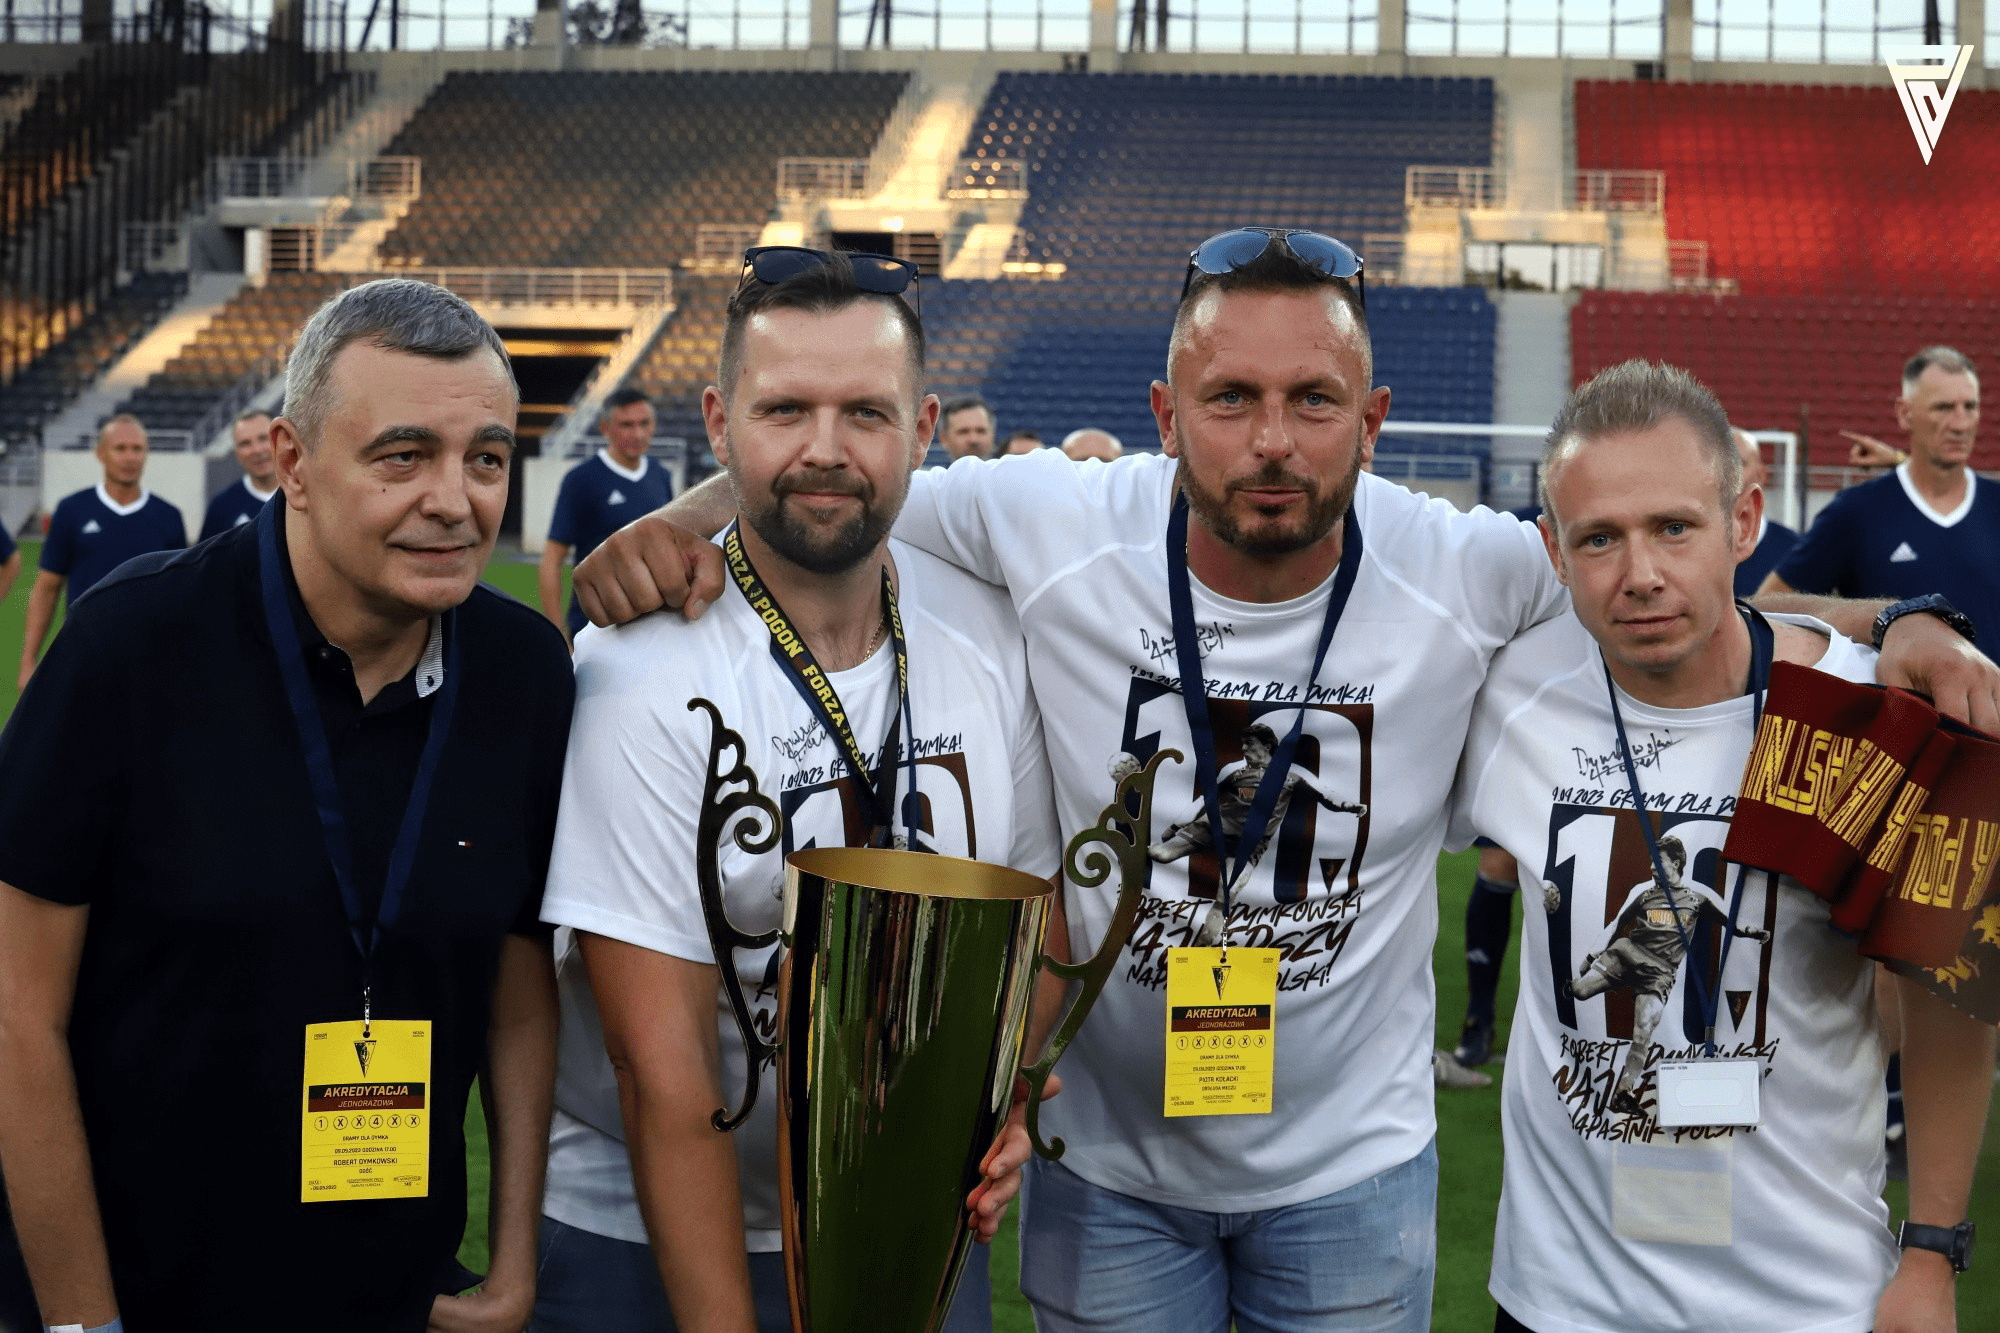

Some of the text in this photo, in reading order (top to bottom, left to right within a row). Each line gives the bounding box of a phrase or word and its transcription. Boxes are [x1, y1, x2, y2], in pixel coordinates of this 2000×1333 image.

[725, 530, 755, 592] FORZA
[802, 664, 846, 728] FORZA
[1203, 679, 1260, 701] RAMY
[1262, 681, 1299, 701] DLA
[1305, 682, 1375, 705] DYMKA!
[1675, 791, 1711, 813] DLA
[1185, 1008, 1257, 1019] AKREDYTACJA
[1197, 1021, 1245, 1029] JEDNORAZOWA
[1559, 1032, 1630, 1069] ROBERT
[323, 1085, 409, 1097] AKREDYTACJA
[338, 1100, 394, 1108] JEDNORAZOWA
